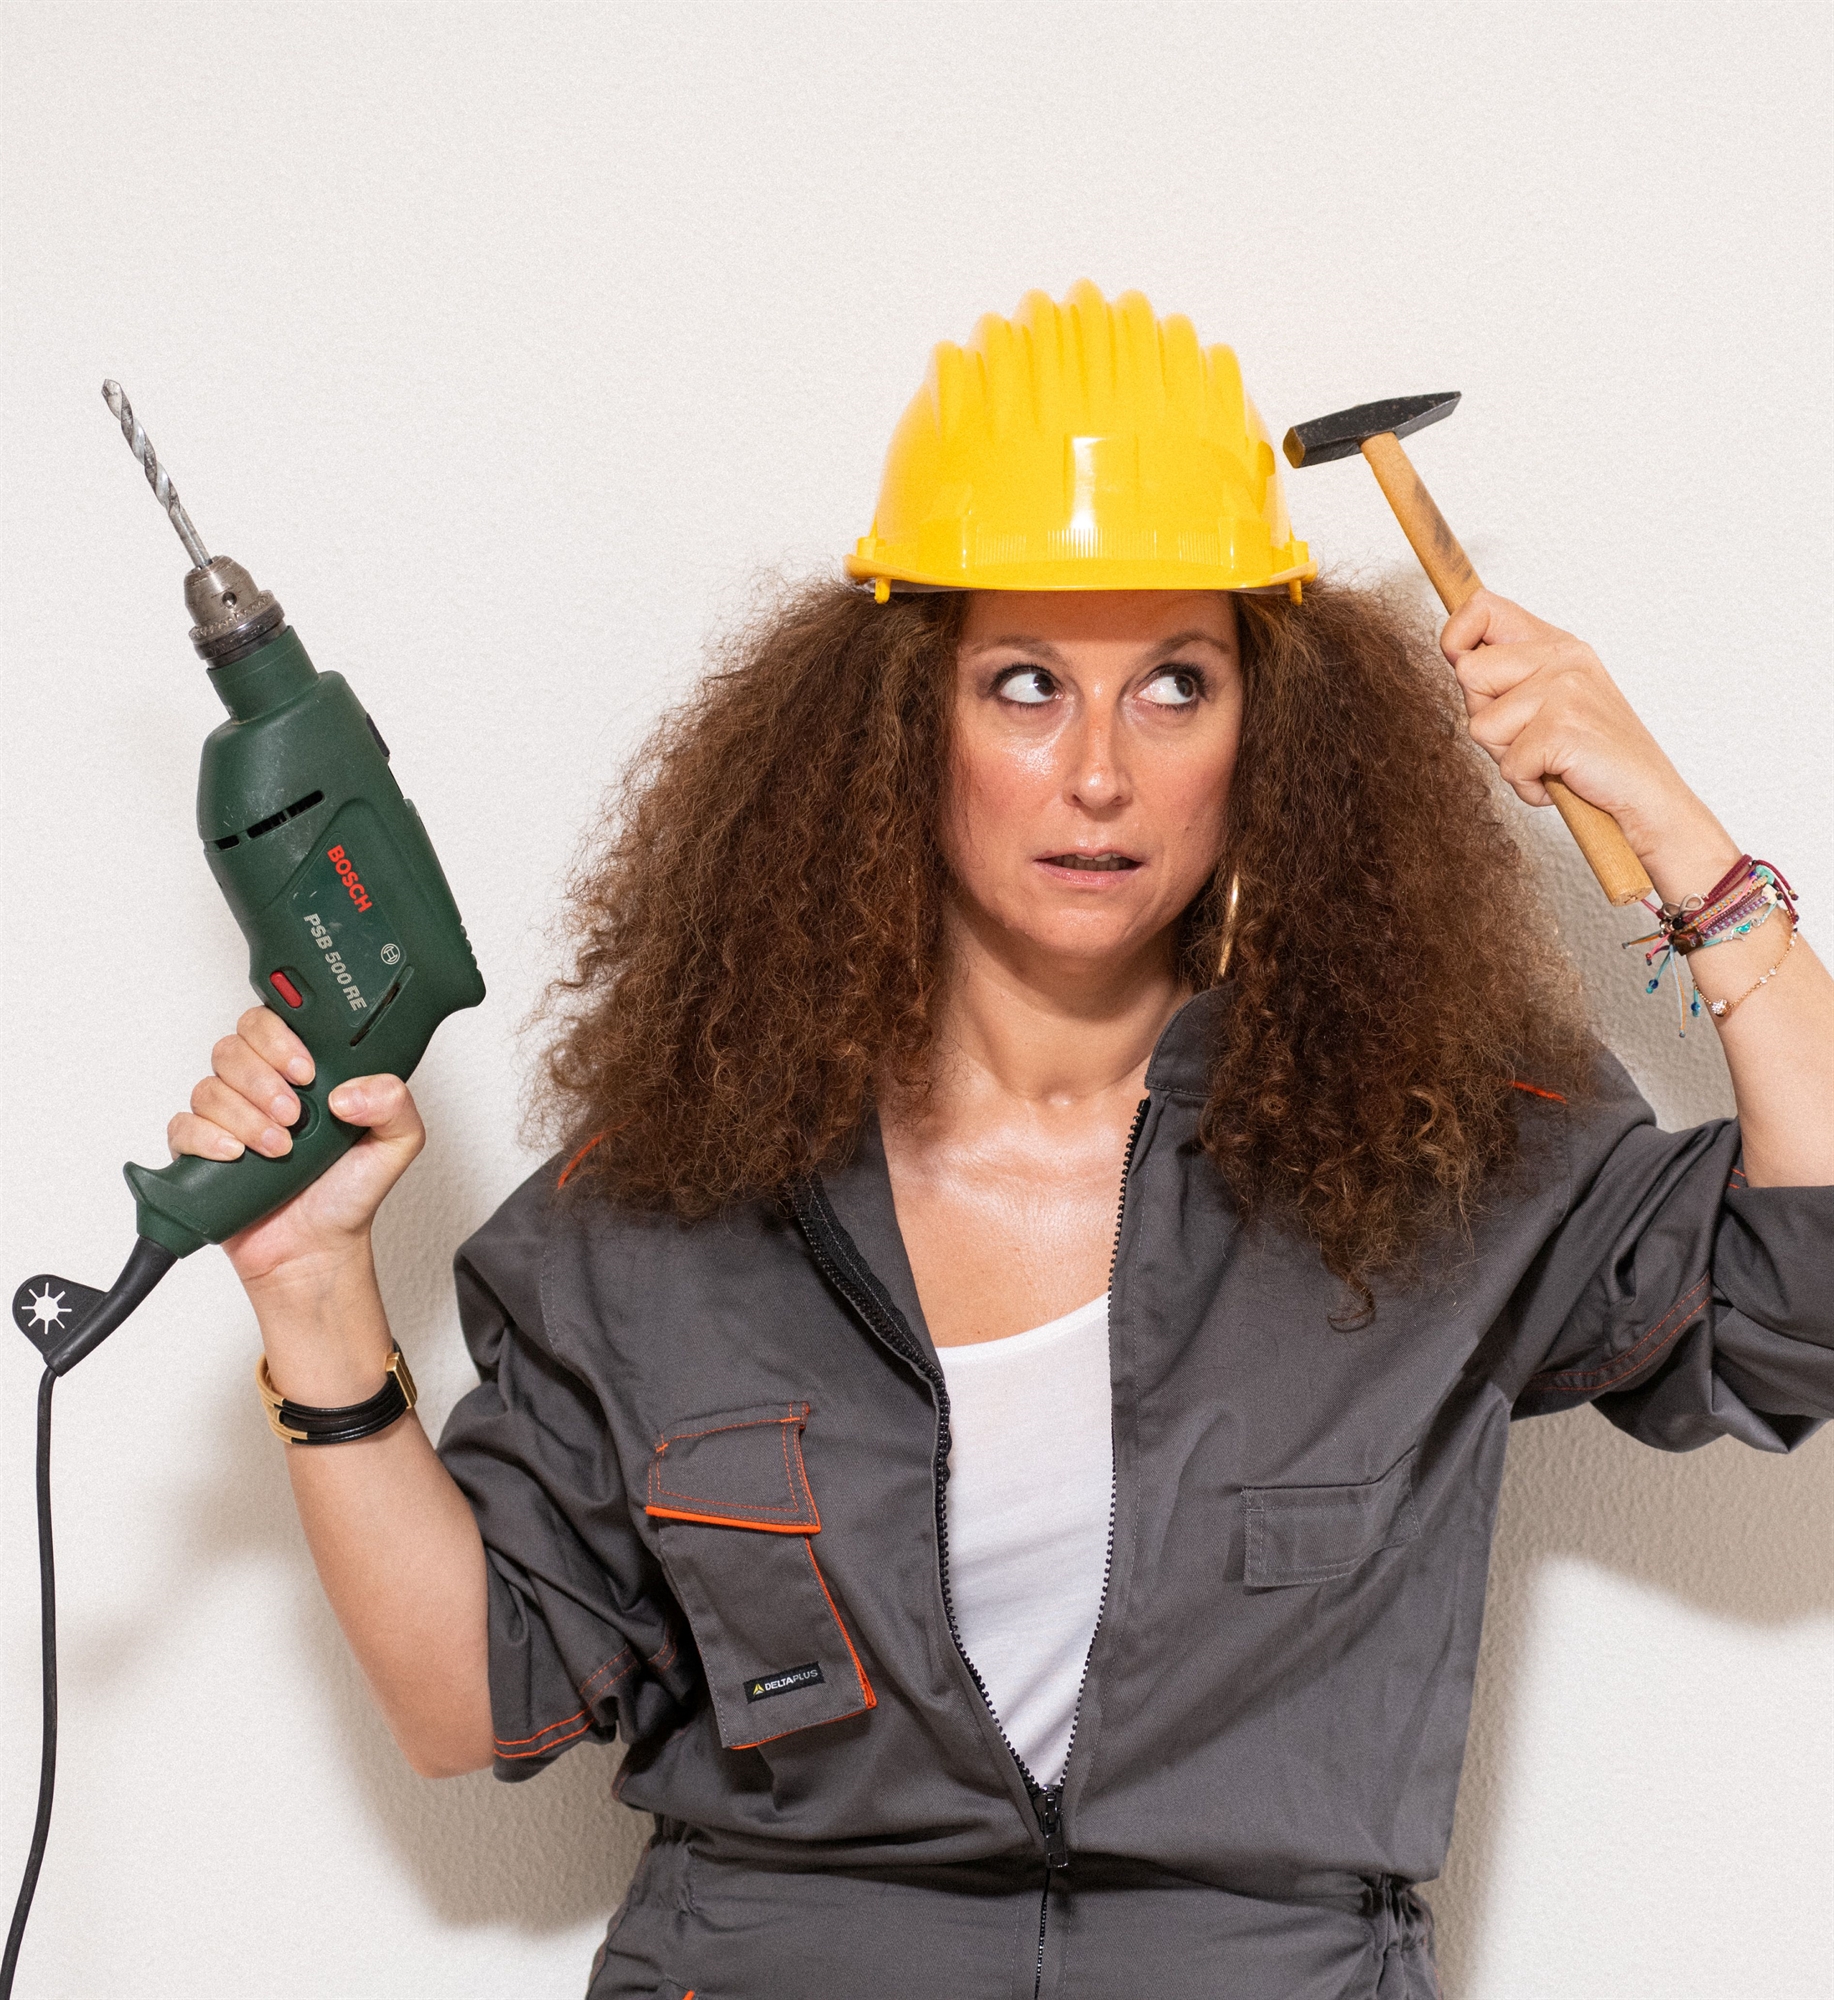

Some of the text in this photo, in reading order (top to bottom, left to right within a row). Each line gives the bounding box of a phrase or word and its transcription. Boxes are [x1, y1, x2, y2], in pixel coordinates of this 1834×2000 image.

[327, 844, 373, 913] BOSCH
[303, 913, 368, 1012] PSB 500 RE
[764, 1669, 818, 1691] DELTAPLUS
